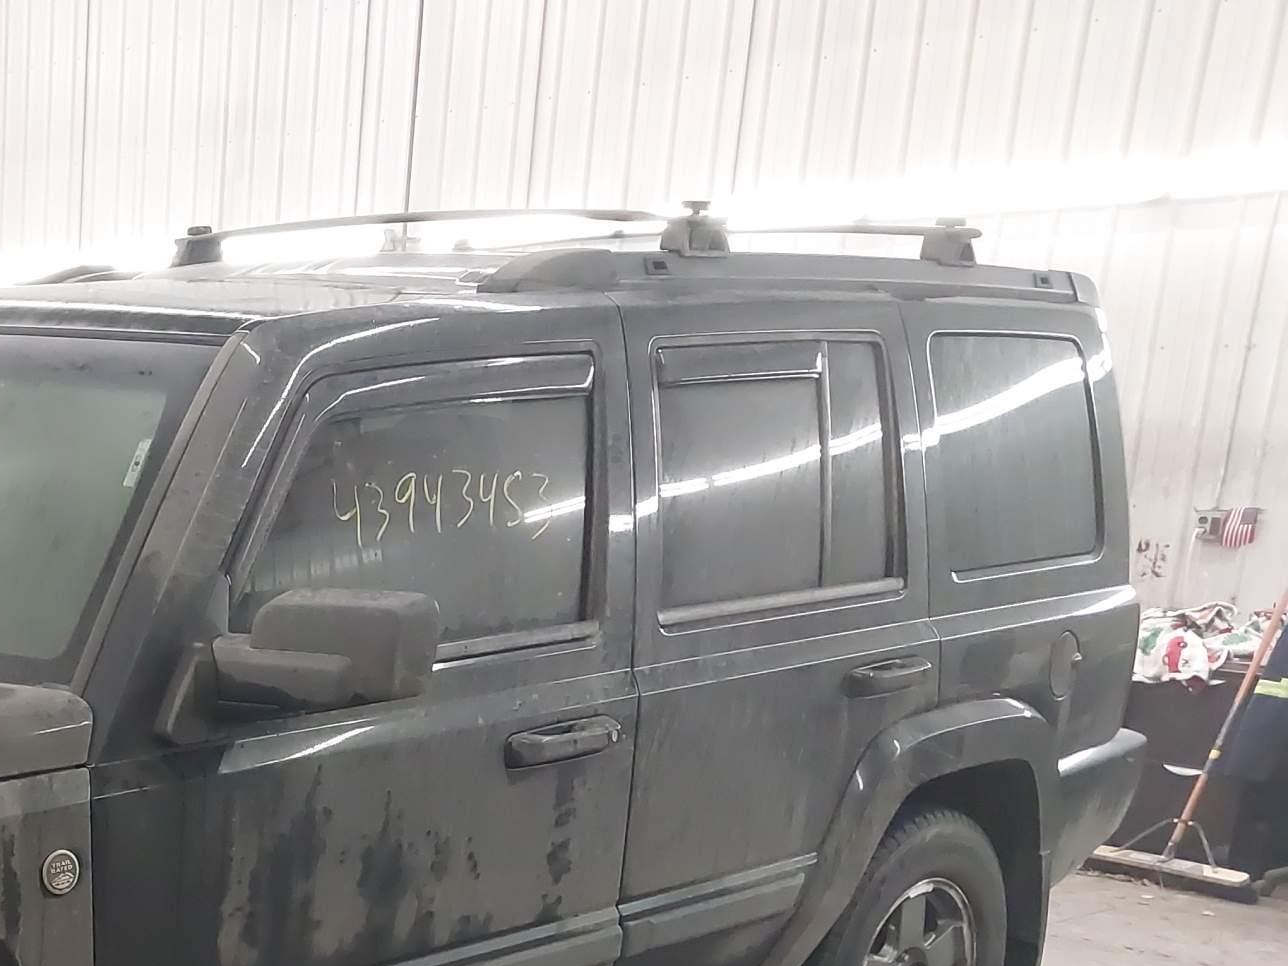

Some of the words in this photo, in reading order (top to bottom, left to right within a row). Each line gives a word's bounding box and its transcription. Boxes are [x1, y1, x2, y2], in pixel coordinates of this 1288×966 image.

[331, 469, 553, 549] 43943453
[51, 859, 72, 869] TRAIL
[50, 865, 73, 874] RATED
